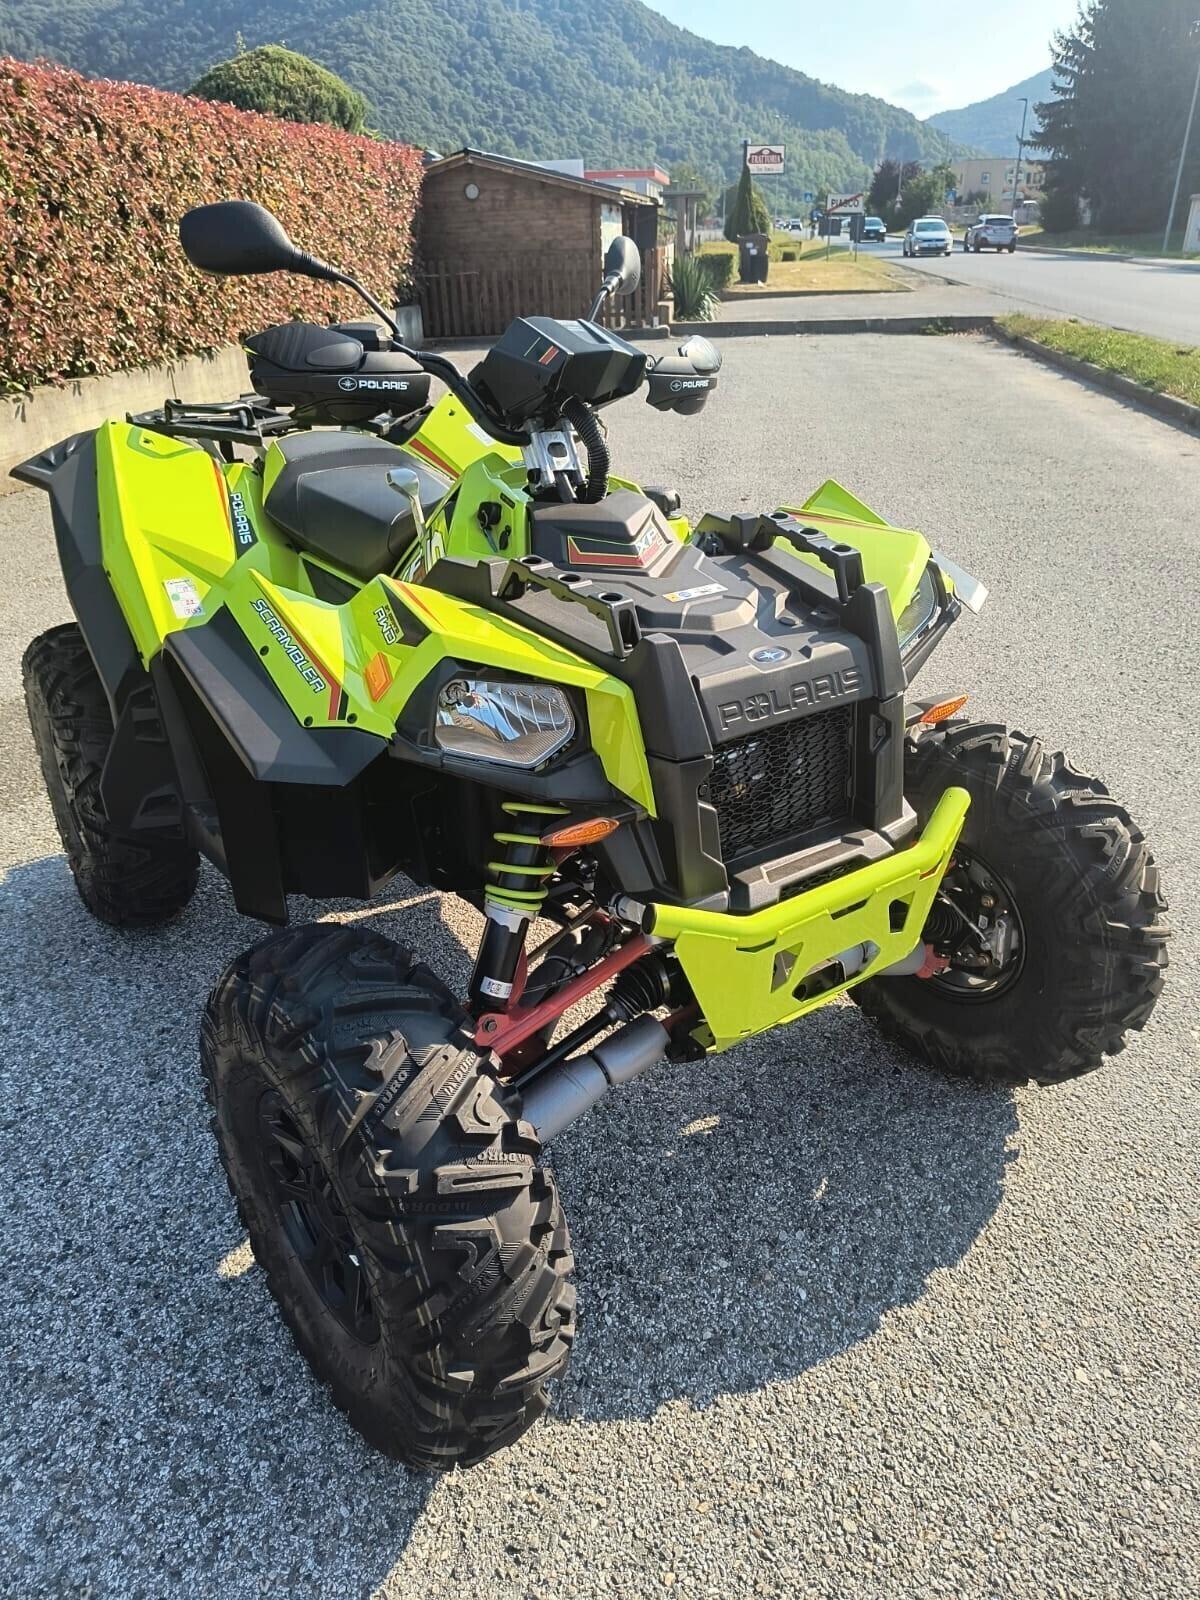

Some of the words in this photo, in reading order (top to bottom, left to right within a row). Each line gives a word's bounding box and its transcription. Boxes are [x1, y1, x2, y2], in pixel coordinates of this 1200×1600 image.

[831, 199, 860, 208] PIASCO
[359, 380, 409, 391] POLARIS
[682, 380, 709, 389] POLARIS
[230, 491, 253, 545] POLARIS
[252, 599, 327, 693] SCRAMBLER
[374, 607, 397, 645] AWD
[717, 666, 861, 731] POLARIS
[374, 1069, 408, 1117] DURO
